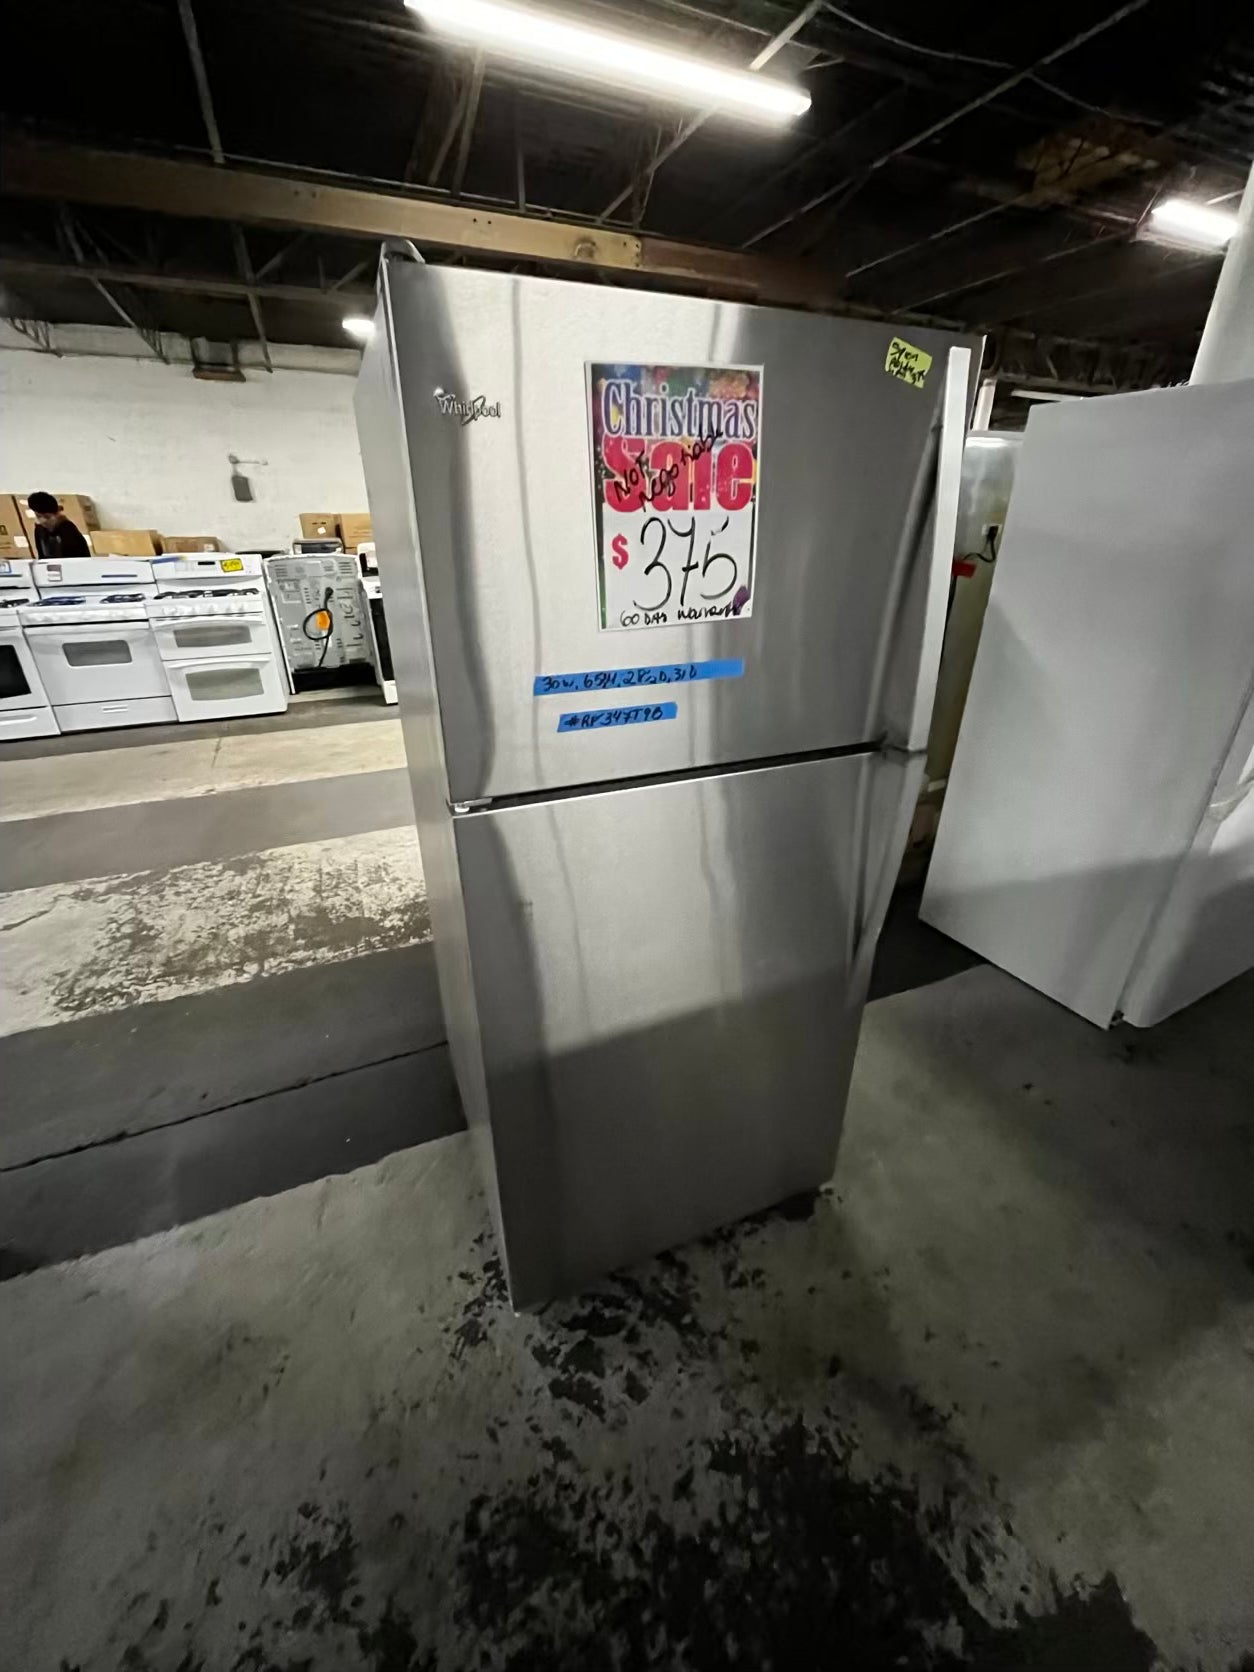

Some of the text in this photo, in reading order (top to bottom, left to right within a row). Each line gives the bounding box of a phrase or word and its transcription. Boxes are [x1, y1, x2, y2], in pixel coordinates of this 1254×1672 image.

[434, 392, 501, 425] Whirlpool
[603, 380, 757, 439] Christmas
[603, 435, 755, 513] Sale
[614, 450, 645, 503] NOT
[611, 516, 738, 612] $ 375
[620, 610, 640, 627] 60
